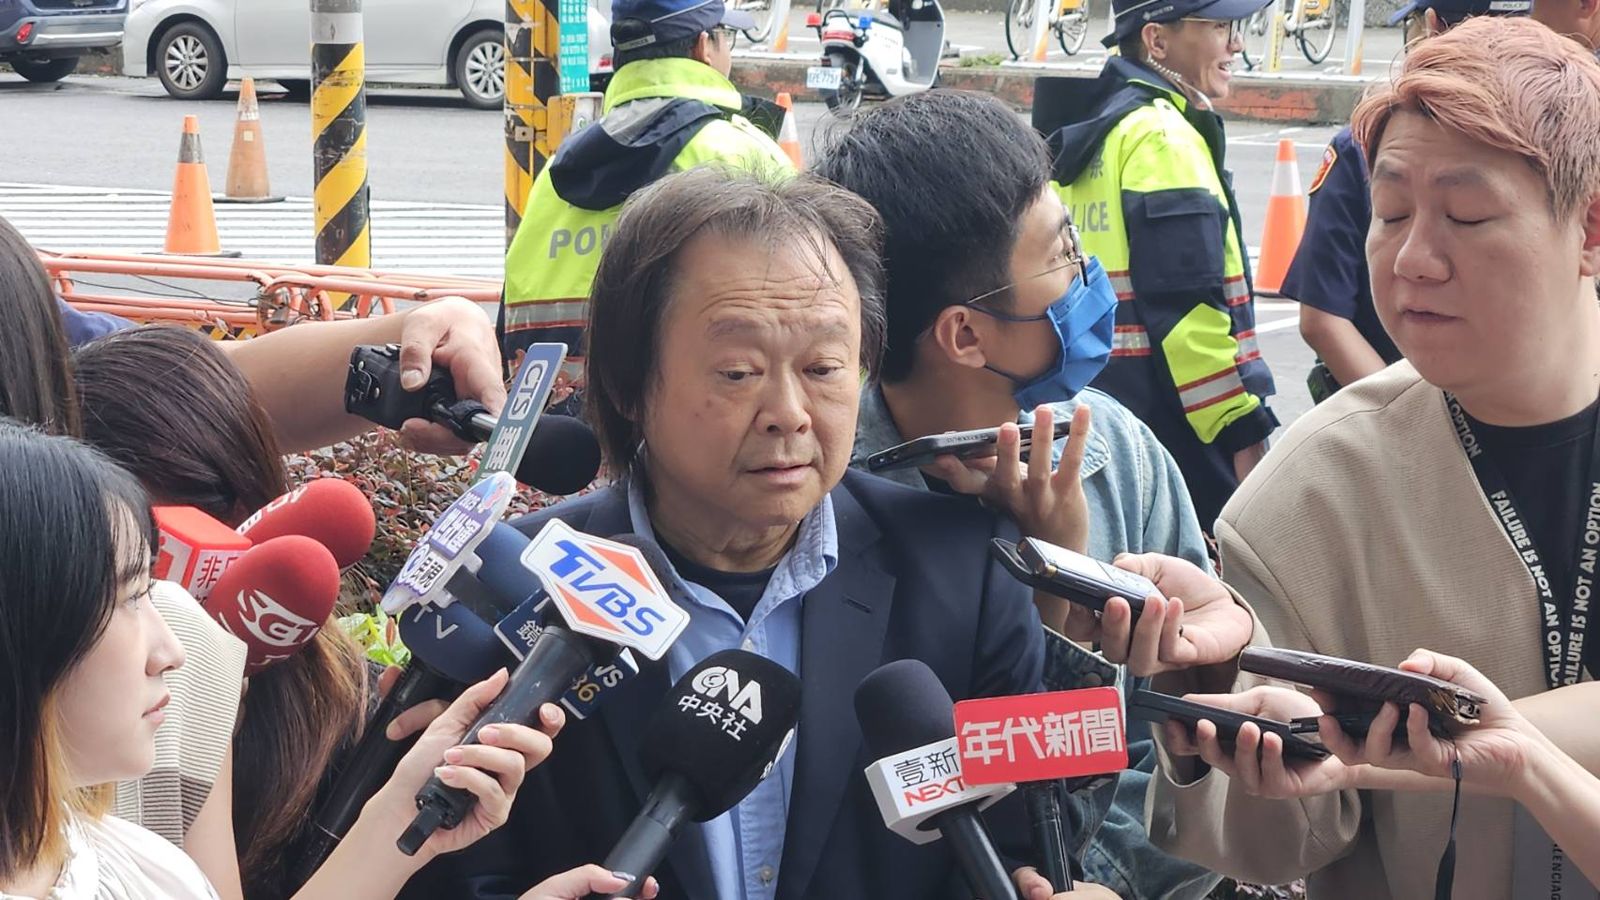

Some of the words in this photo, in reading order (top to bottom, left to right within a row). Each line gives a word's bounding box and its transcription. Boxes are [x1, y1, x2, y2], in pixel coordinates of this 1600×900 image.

[511, 363, 543, 416] CTS
[481, 425, 523, 479] 華
[1490, 490, 1532, 549] FAILURE
[1521, 549, 1540, 564] IS
[1580, 548, 1598, 574] AN
[550, 538, 665, 638] TVBS
[1530, 564, 1553, 599] NOT
[1573, 575, 1593, 612] NOT
[1543, 602, 1560, 627] AN
[1570, 613, 1587, 629] IS
[678, 694, 747, 741] 中央社
[691, 666, 763, 725] CNA
[961, 707, 1124, 765] 年代新聞
